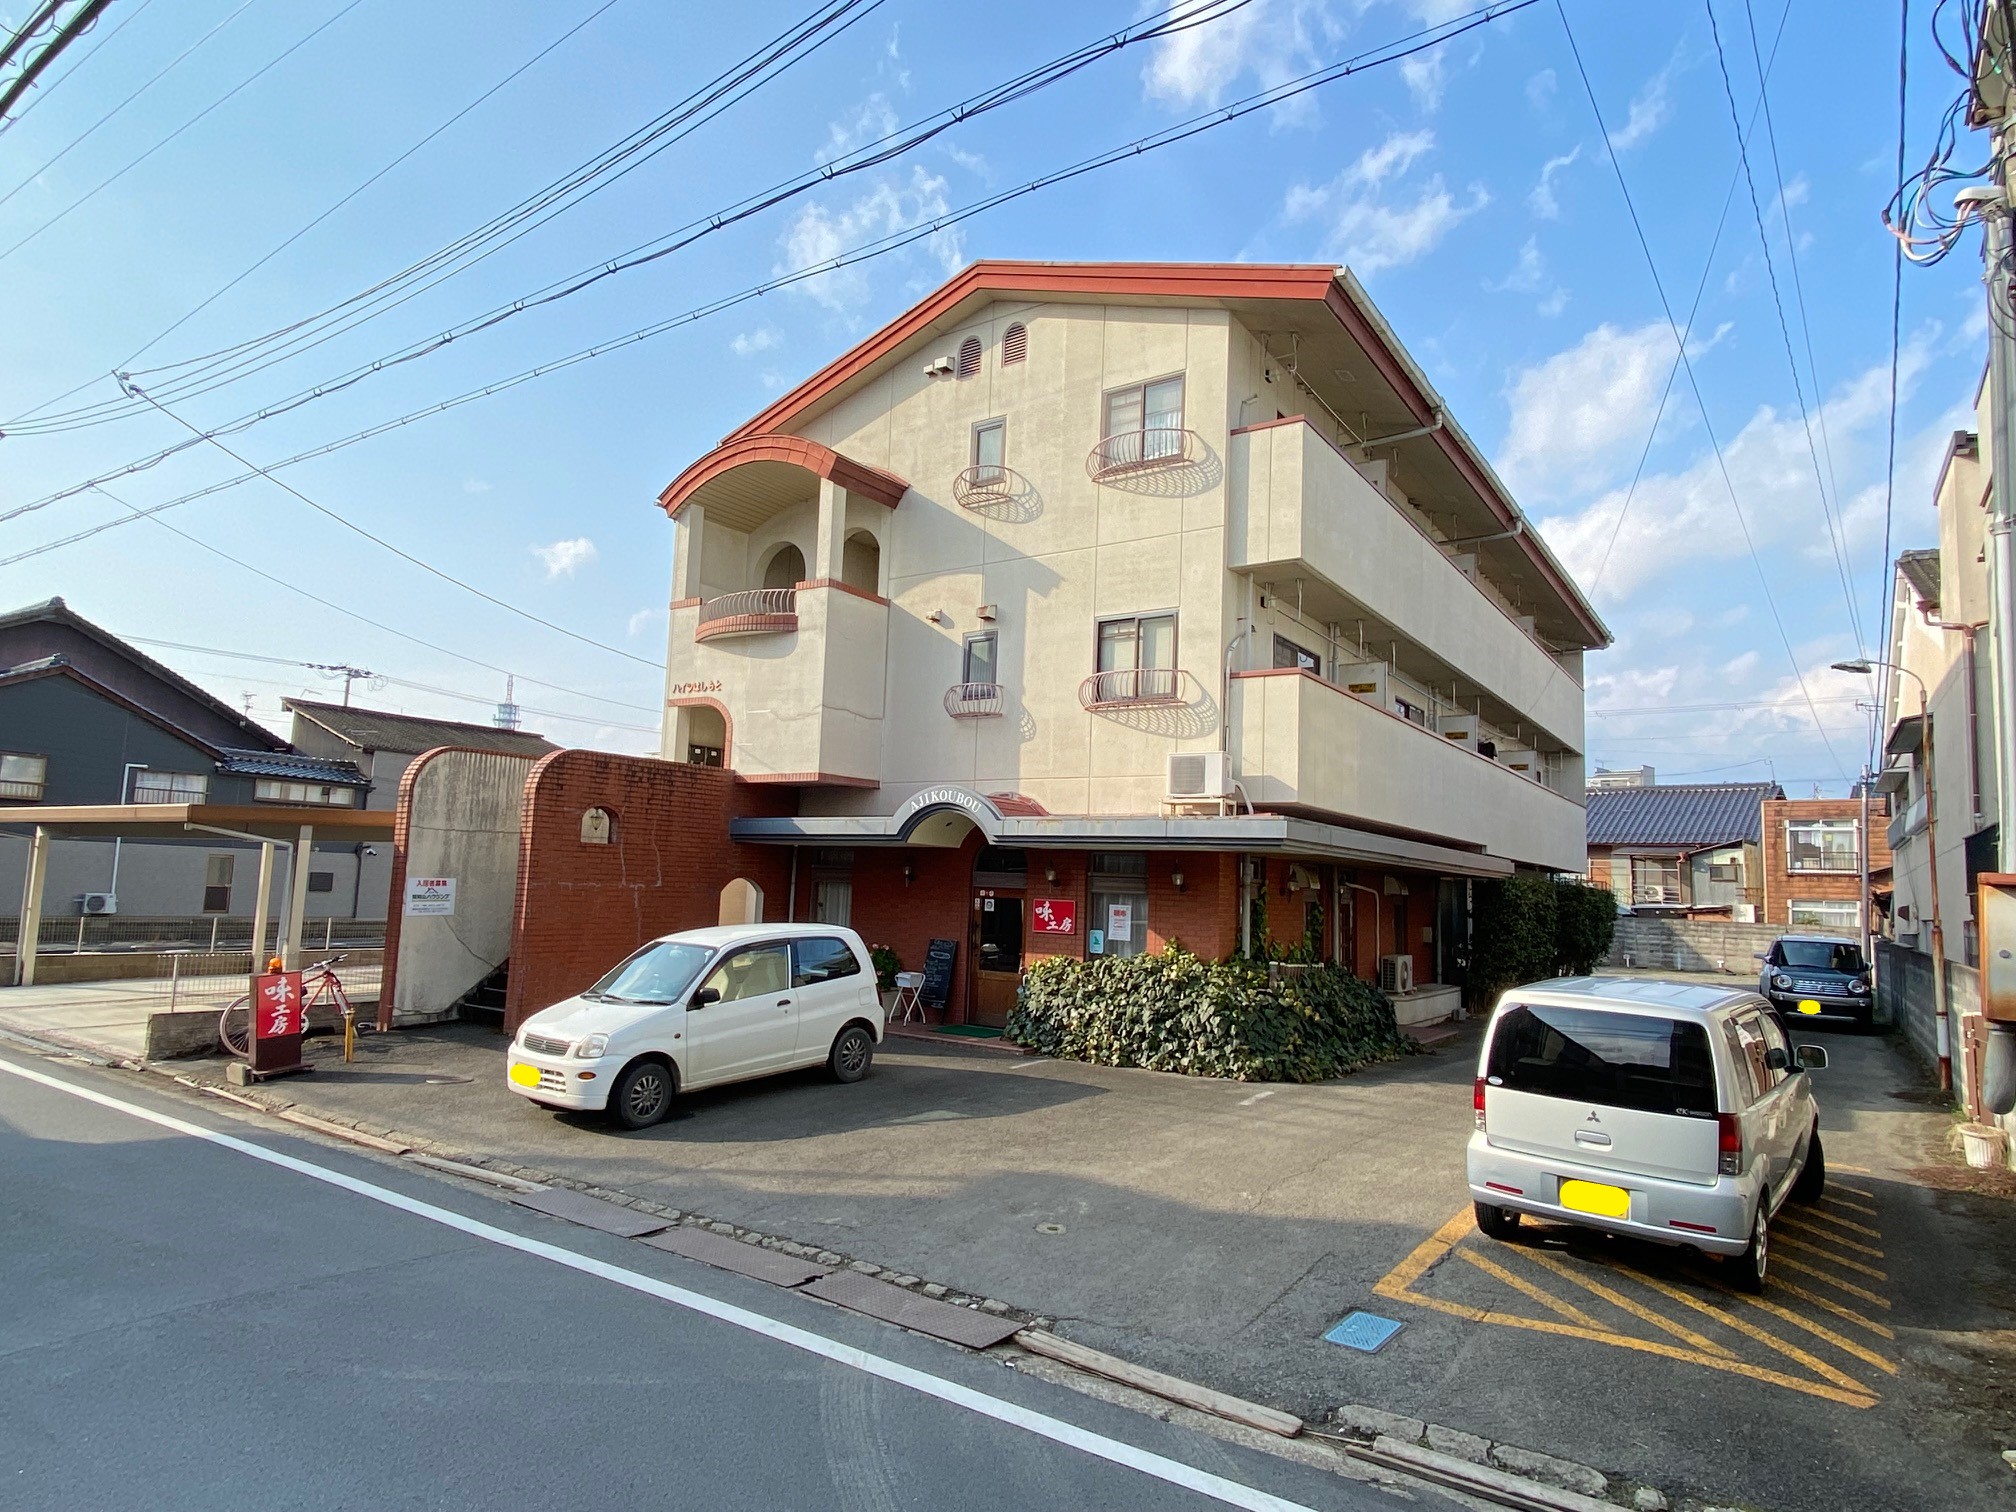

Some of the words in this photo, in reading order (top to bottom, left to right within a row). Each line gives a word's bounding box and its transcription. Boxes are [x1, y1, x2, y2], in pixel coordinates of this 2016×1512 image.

[910, 789, 982, 813] AJIKOUBOU
[1035, 900, 1072, 932] 味工房
[264, 976, 295, 1035] 味工房
